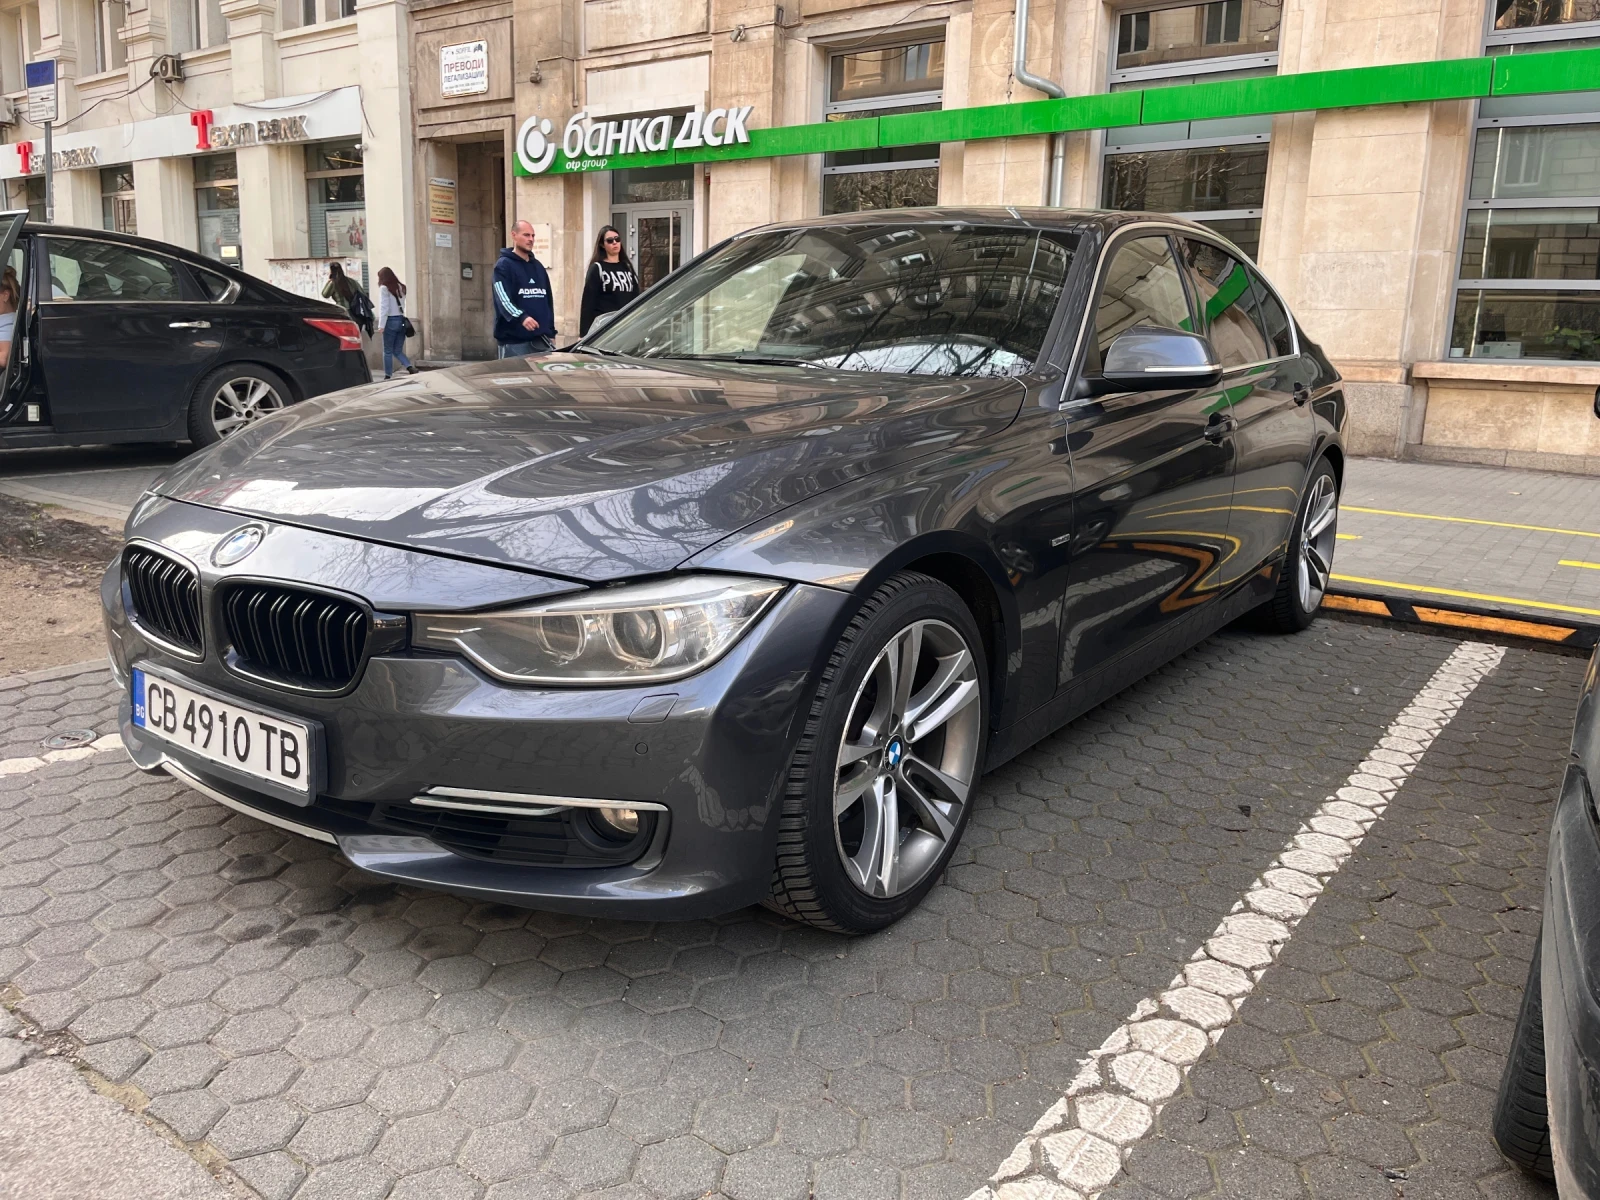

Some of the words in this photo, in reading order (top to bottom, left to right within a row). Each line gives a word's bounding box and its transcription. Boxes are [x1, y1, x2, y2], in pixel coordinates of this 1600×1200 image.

[443, 58, 484, 74] ПРЕВОДИ
[563, 111, 674, 159] банка
[672, 105, 753, 149] ДСК
[565, 161, 581, 170] otp
[581, 158, 608, 171] group
[518, 287, 547, 295] ADIDAS
[135, 703, 145, 718] BG
[183, 699, 251, 763] 4910
